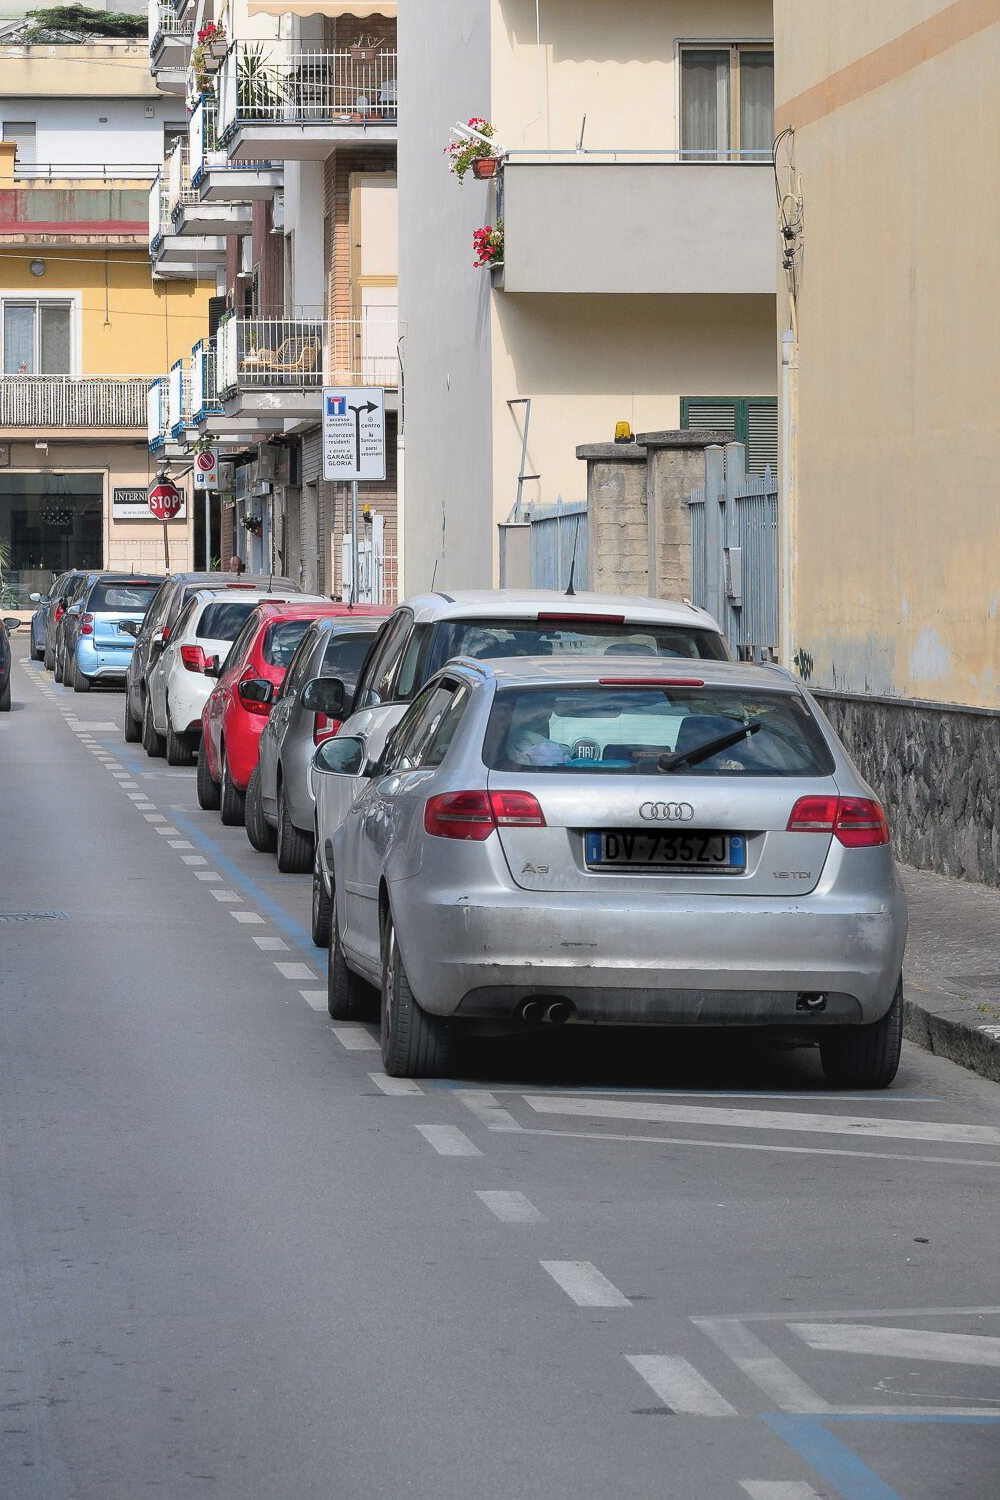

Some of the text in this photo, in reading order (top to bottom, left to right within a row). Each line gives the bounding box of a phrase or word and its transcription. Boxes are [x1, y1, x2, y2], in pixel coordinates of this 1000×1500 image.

[151, 495, 179, 510] STOP
[578, 746, 595, 758] FIAT
[604, 834, 635, 860] DV
[649, 834, 727, 862] 735ZJ
[521, 862, 550, 874] A3
